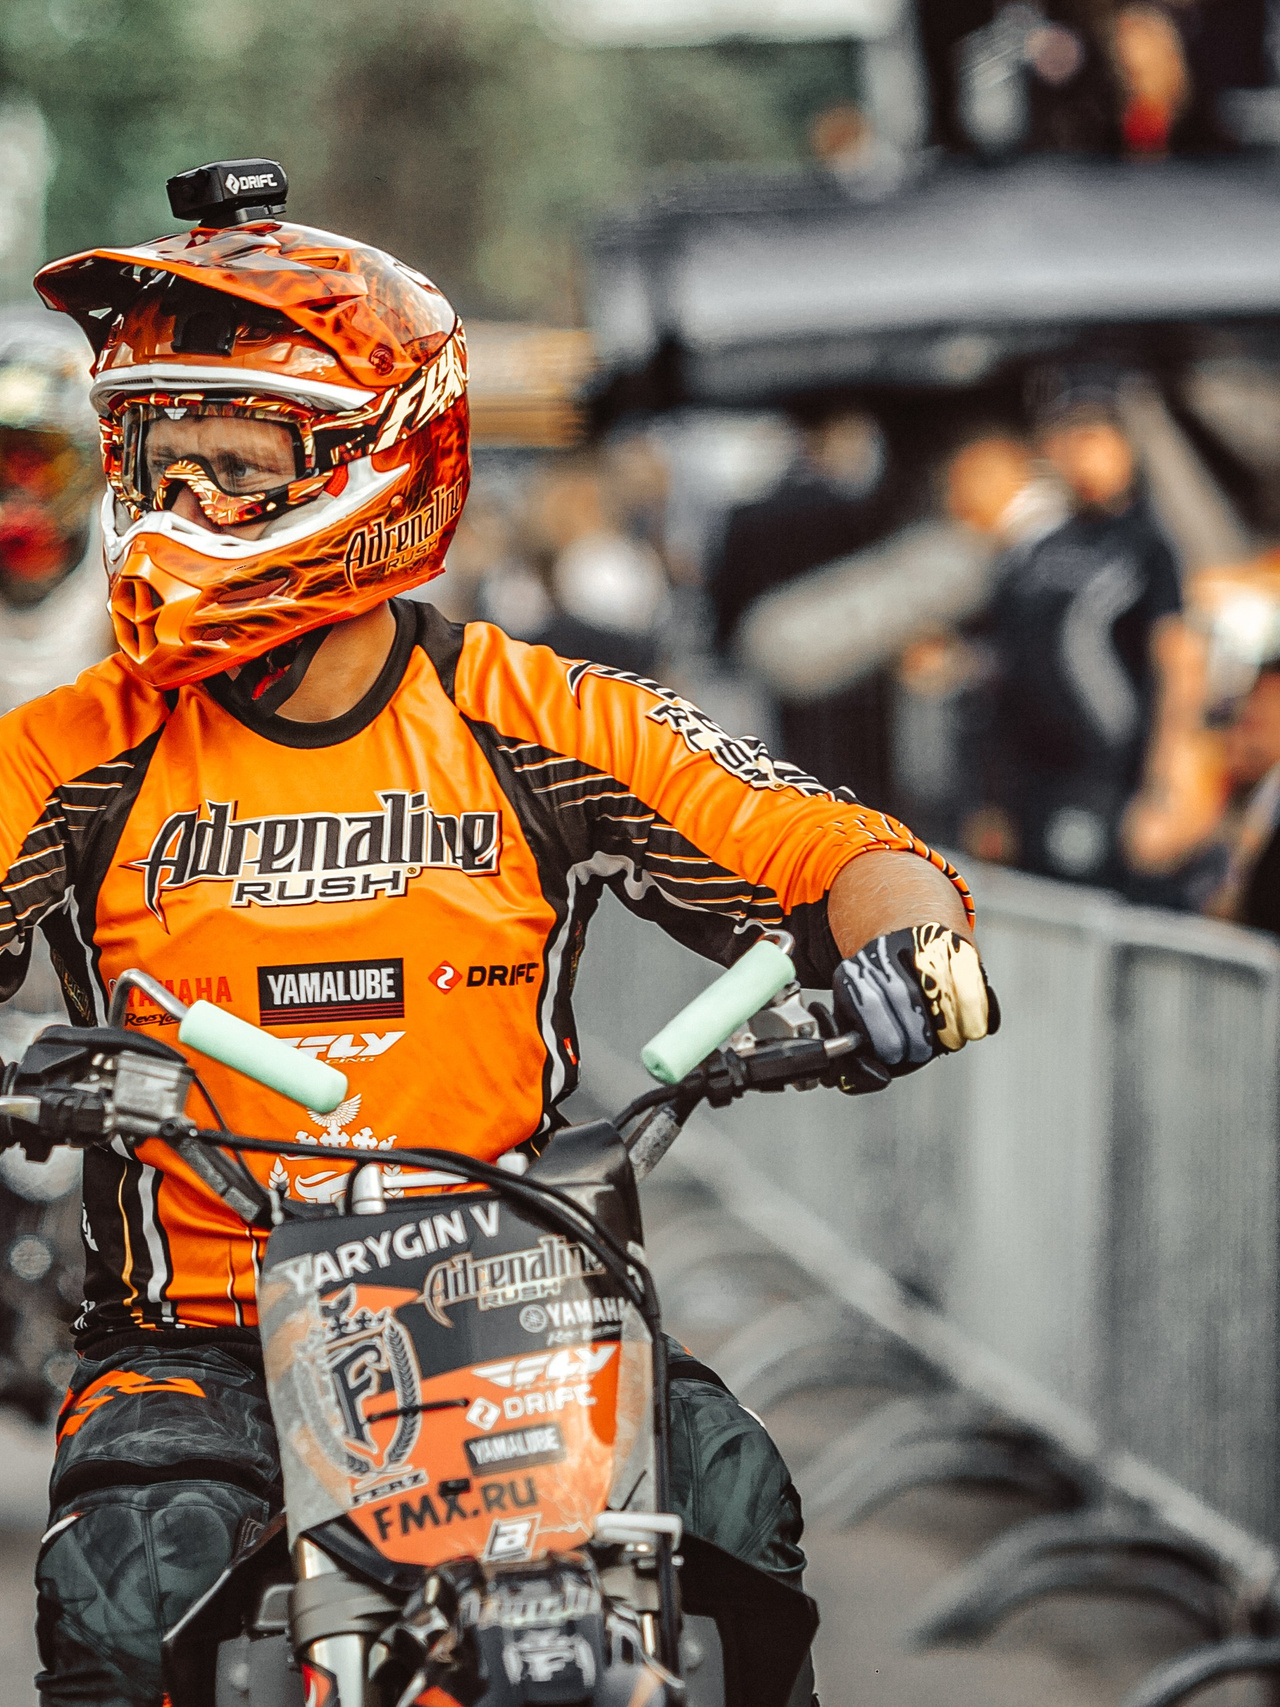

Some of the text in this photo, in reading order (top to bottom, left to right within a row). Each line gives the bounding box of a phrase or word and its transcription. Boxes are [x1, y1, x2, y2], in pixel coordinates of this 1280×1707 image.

[239, 173, 278, 190] DRIFT
[386, 538, 438, 571] RUSH
[129, 789, 502, 928] Adrenaline
[233, 869, 404, 905] RUSH
[266, 967, 396, 1006] YAMALUBE
[466, 962, 539, 987] DRIFT
[324, 1056, 376, 1064] CING
[285, 1200, 500, 1296] YARYGIN V
[373, 1477, 539, 1541] FMX.RU
